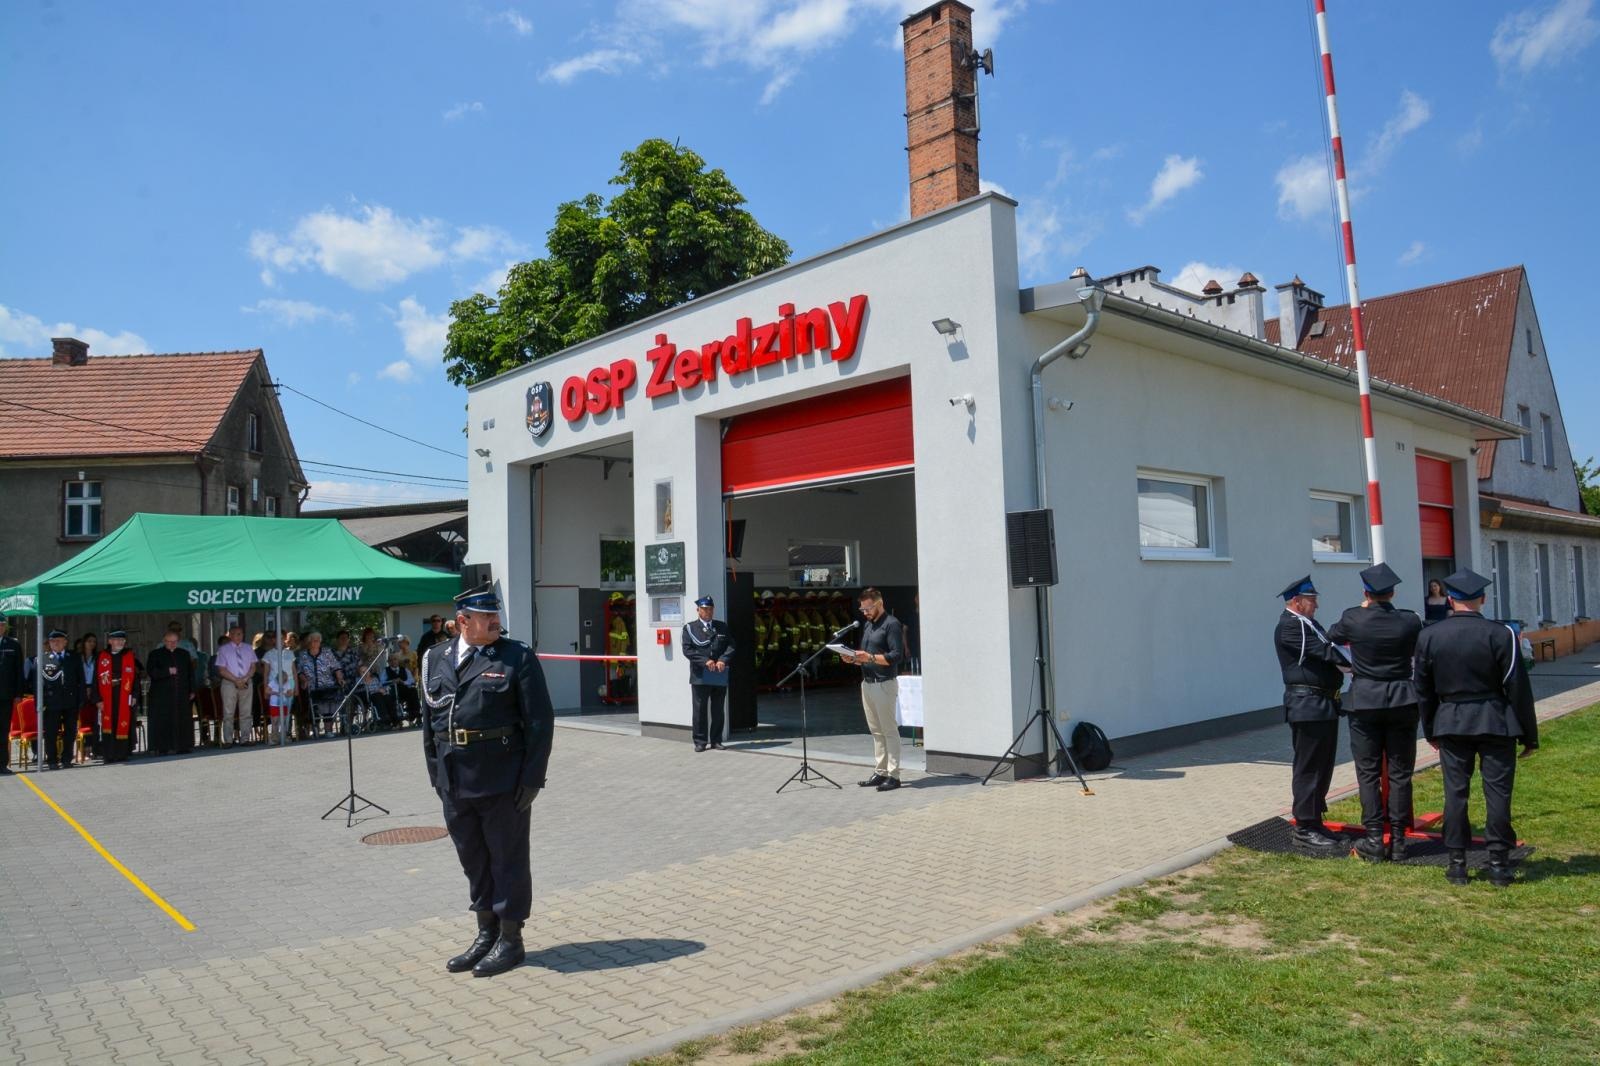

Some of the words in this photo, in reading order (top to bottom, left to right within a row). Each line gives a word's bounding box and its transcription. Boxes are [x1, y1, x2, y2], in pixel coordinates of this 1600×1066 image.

[560, 358, 636, 422] OSP
[646, 294, 868, 398] Żerdziny
[531, 384, 543, 395] OSP
[187, 588, 282, 605] SOŁECTWO
[286, 585, 363, 603] ŻERDZINY
